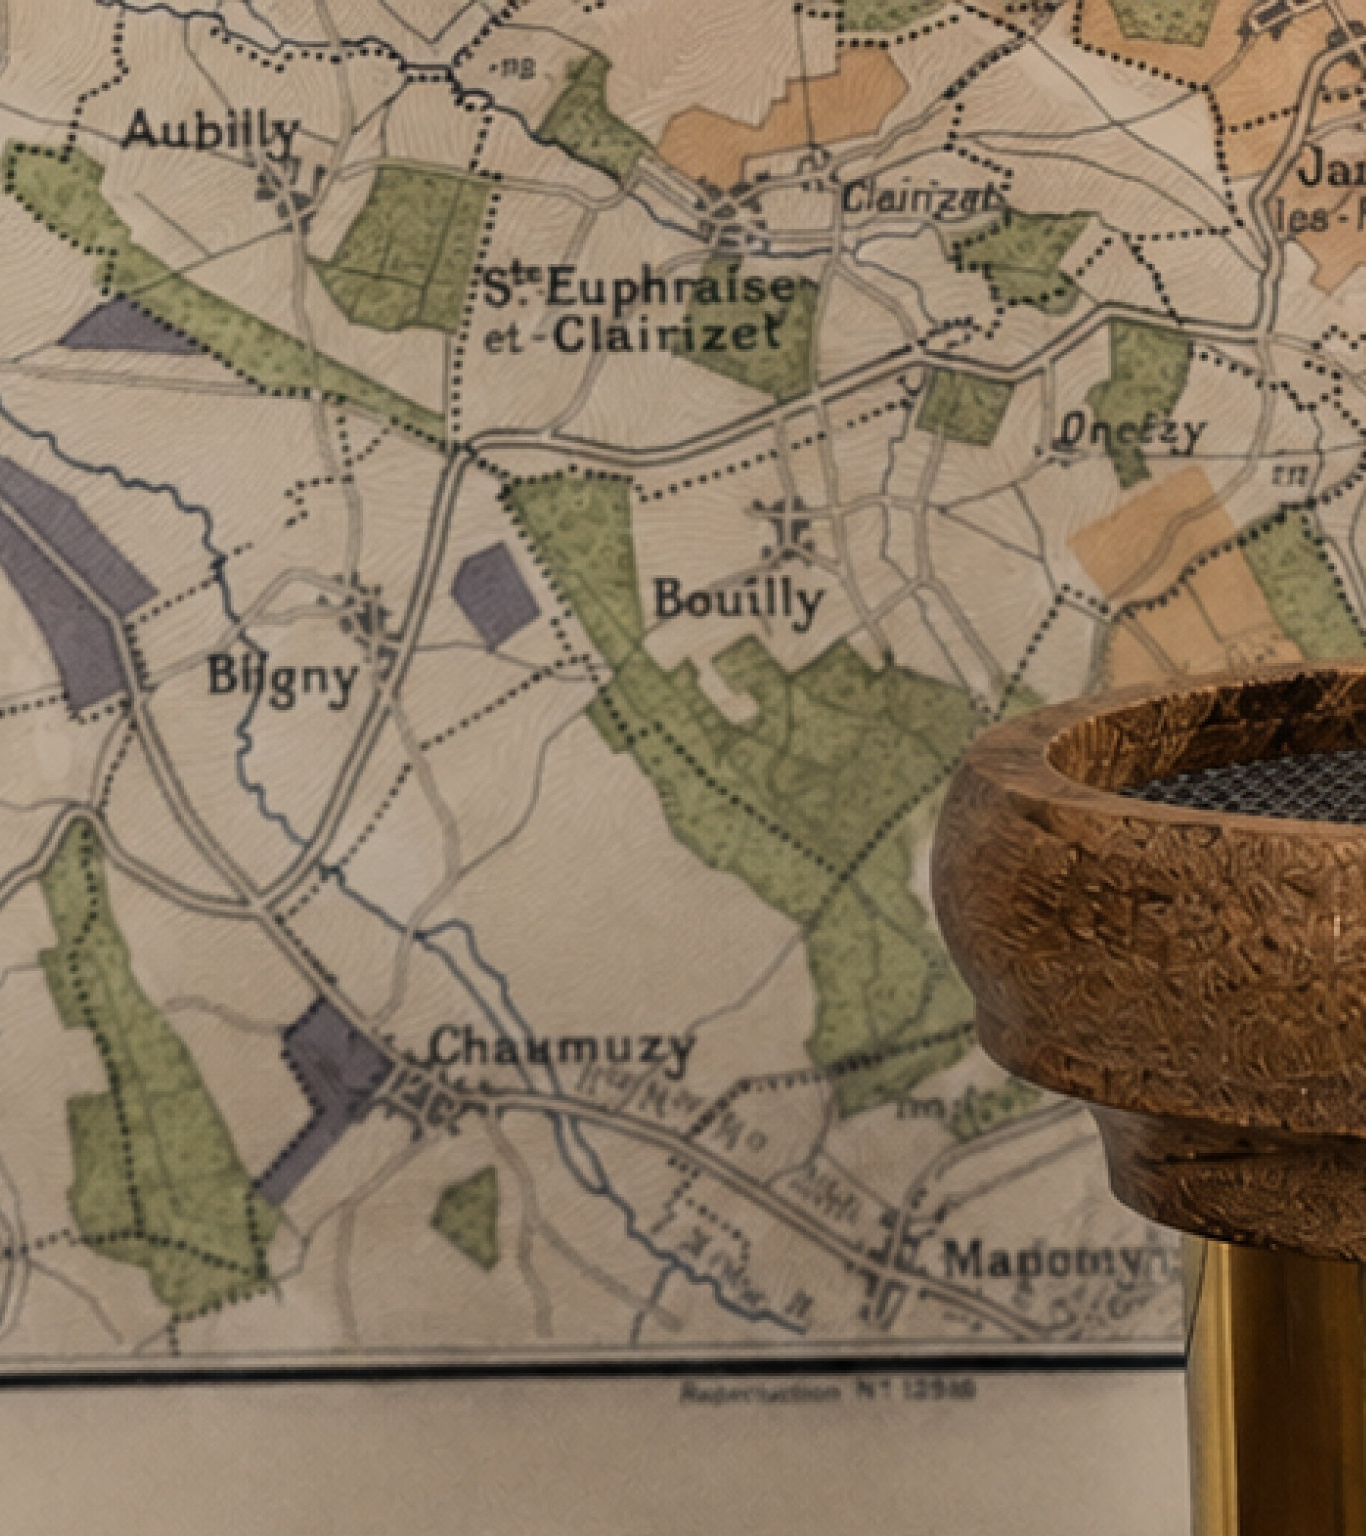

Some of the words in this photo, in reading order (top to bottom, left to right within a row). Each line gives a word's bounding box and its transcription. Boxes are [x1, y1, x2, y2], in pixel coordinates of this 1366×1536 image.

[121, 107, 302, 162] Aubilly
[653, 575, 828, 634] Bouilly
[207, 653, 361, 712] Bligny
[428, 1023, 698, 1080] Chaumuzy
